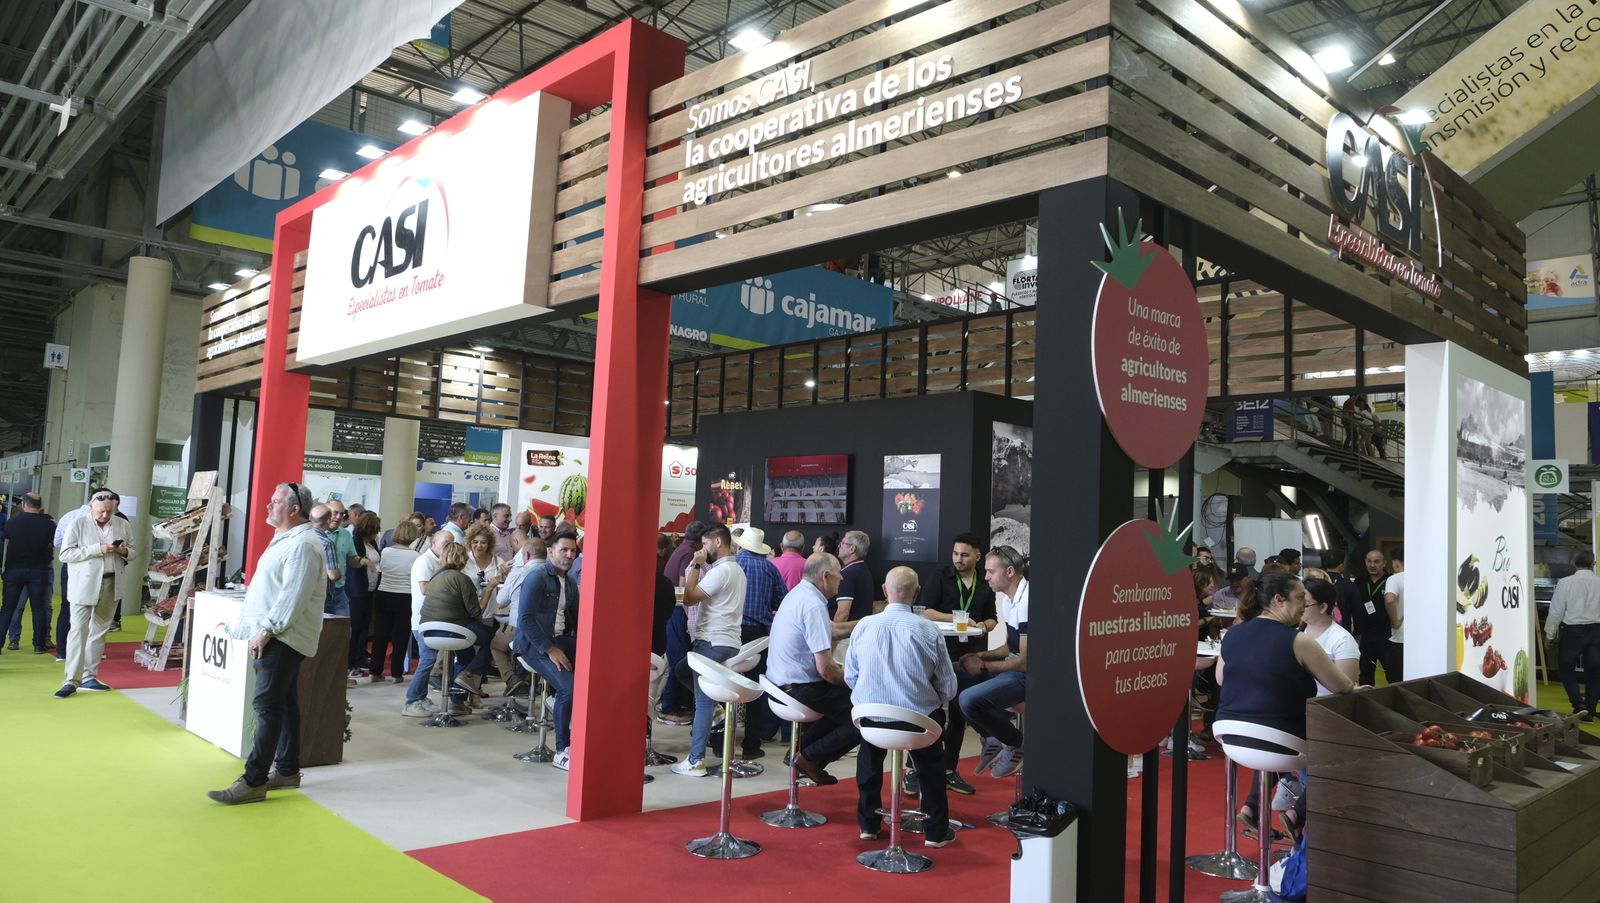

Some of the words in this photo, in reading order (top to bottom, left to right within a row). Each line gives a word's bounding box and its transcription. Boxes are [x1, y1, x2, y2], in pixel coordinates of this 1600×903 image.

[1529, 56, 1547, 79] y
[1549, 16, 1600, 61] reco
[1426, 47, 1525, 123] ecialistas
[1527, 23, 1559, 49] en
[1555, 4, 1584, 24] la
[685, 139, 704, 168] la
[708, 88, 857, 154] cooperativa
[863, 71, 900, 106] de
[907, 54, 953, 92] los
[687, 92, 751, 133] Somos
[683, 138, 825, 205] agricultores
[830, 74, 1023, 158] almerienses
[1326, 112, 1421, 256] CASI
[351, 198, 429, 289] CASI
[347, 286, 396, 321] Especialistas
[398, 284, 409, 300] en
[411, 268, 445, 297] Tomate
[678, 292, 709, 307] RURAL
[781, 293, 877, 333] cajamar
[1128, 297, 1149, 320] Una
[1151, 308, 1181, 329] marca
[670, 324, 707, 342] NAGRO
[1128, 326, 1141, 346] de
[1143, 330, 1167, 352] éxito
[1169, 337, 1181, 356] de
[1121, 357, 1187, 385] agricultores
[1121, 383, 1187, 411] almerienses
[473, 473, 500, 482] cesce
[684, 467, 697, 476] SO
[1492, 535, 1511, 573] Bio
[1111, 583, 1172, 604] Sembramos
[1501, 586, 1520, 609] CASI
[1089, 615, 1141, 637] nuestras
[1143, 610, 1191, 631] ilusiones
[203, 633, 228, 670] CASI
[1105, 646, 1130, 670] para
[1132, 639, 1177, 661] cosechar
[1115, 676, 1132, 694] tus
[1133, 670, 1168, 691] deseos
